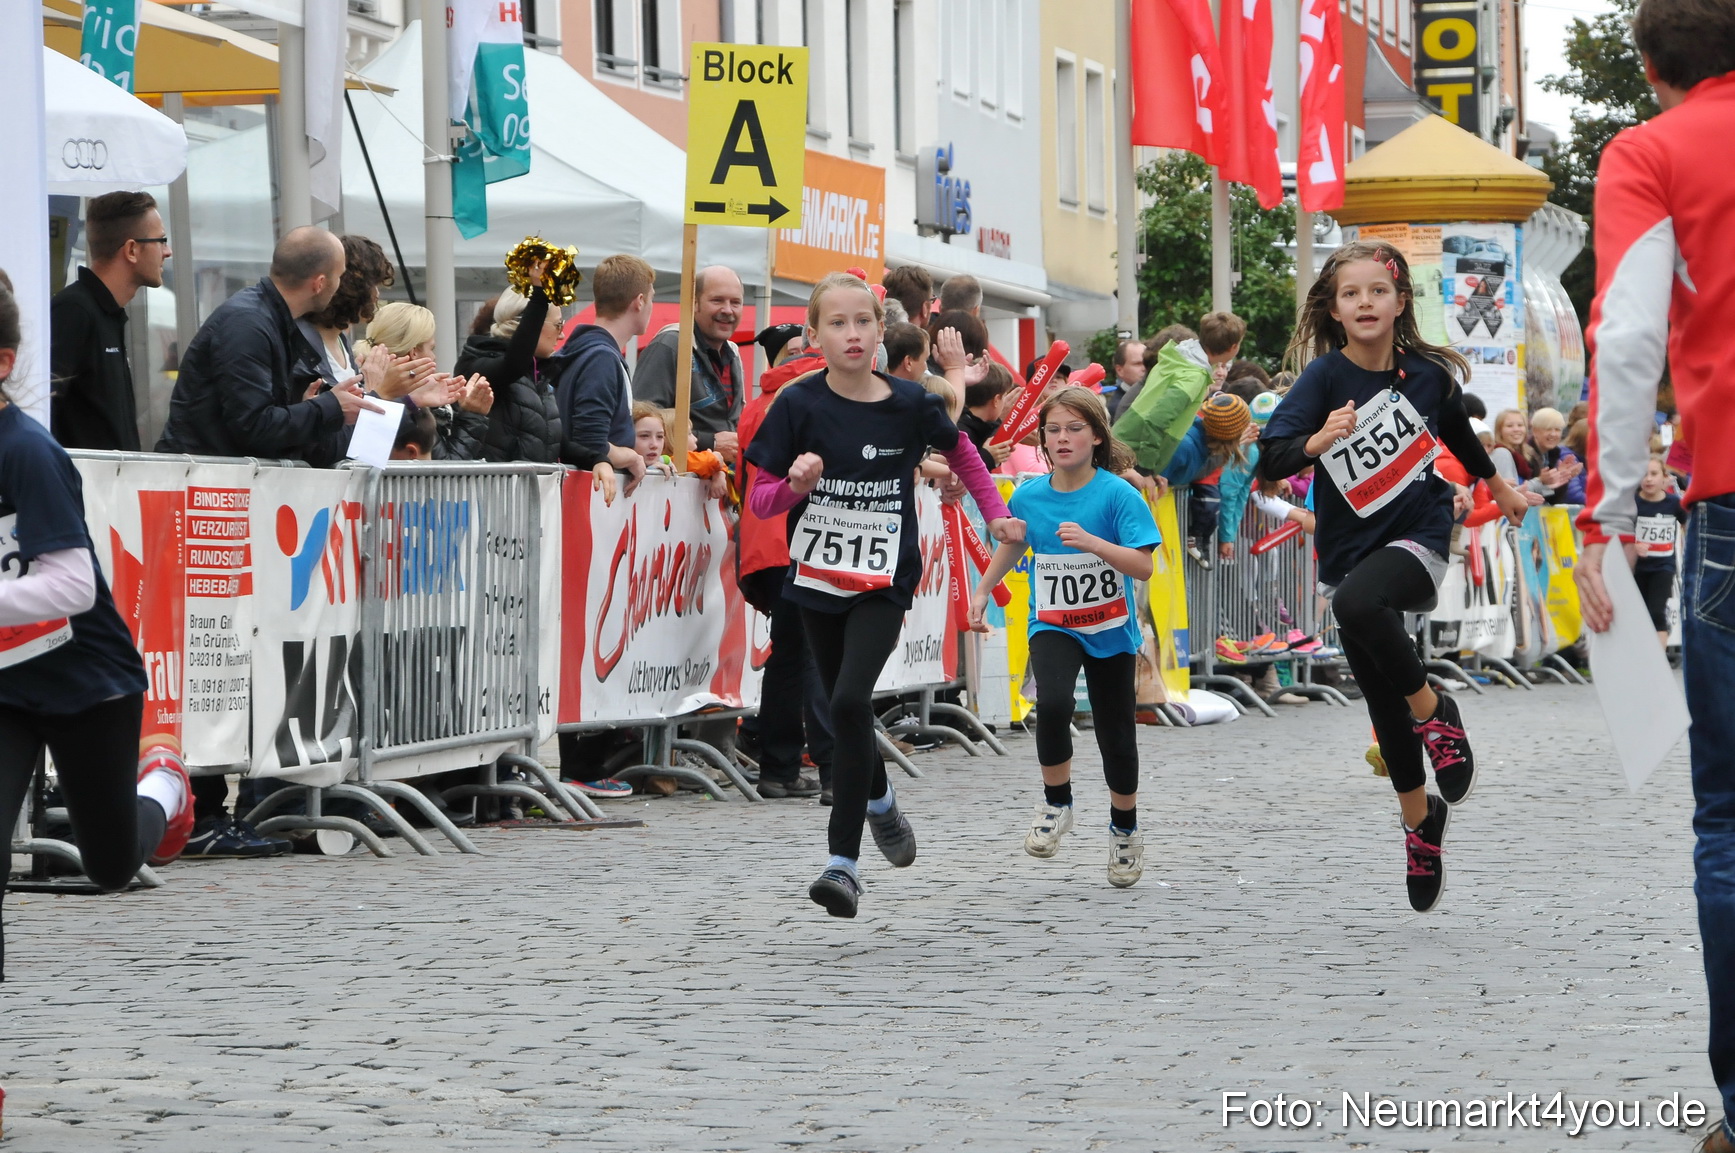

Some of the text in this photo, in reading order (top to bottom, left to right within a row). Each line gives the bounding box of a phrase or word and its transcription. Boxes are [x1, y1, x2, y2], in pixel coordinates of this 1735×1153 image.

[703, 50, 794, 85] Block
[709, 99, 778, 187] A
[1003, 390, 1032, 432] Audi BKK
[1018, 414, 1039, 432] Audi
[1332, 408, 1416, 482] 7554
[815, 477, 901, 498] RUNDSCHULE
[1356, 468, 1400, 502] THERESA
[833, 517, 882, 532] Neumarkt
[1641, 526, 1673, 541] 7545
[802, 527, 889, 572] 7515
[943, 519, 956, 567] Audi BKK
[965, 525, 989, 564] Audi BKK
[1037, 560, 1107, 571] PARTL Neumarkt
[1043, 569, 1118, 606] 7028
[190, 614, 216, 629] Braun
[1061, 611, 1105, 626] Alessia
[46, 632, 69, 649] 2005
[190, 652, 222, 667] D-92318
[189, 679, 200, 693] Tel.
[189, 698, 200, 712] Fax
